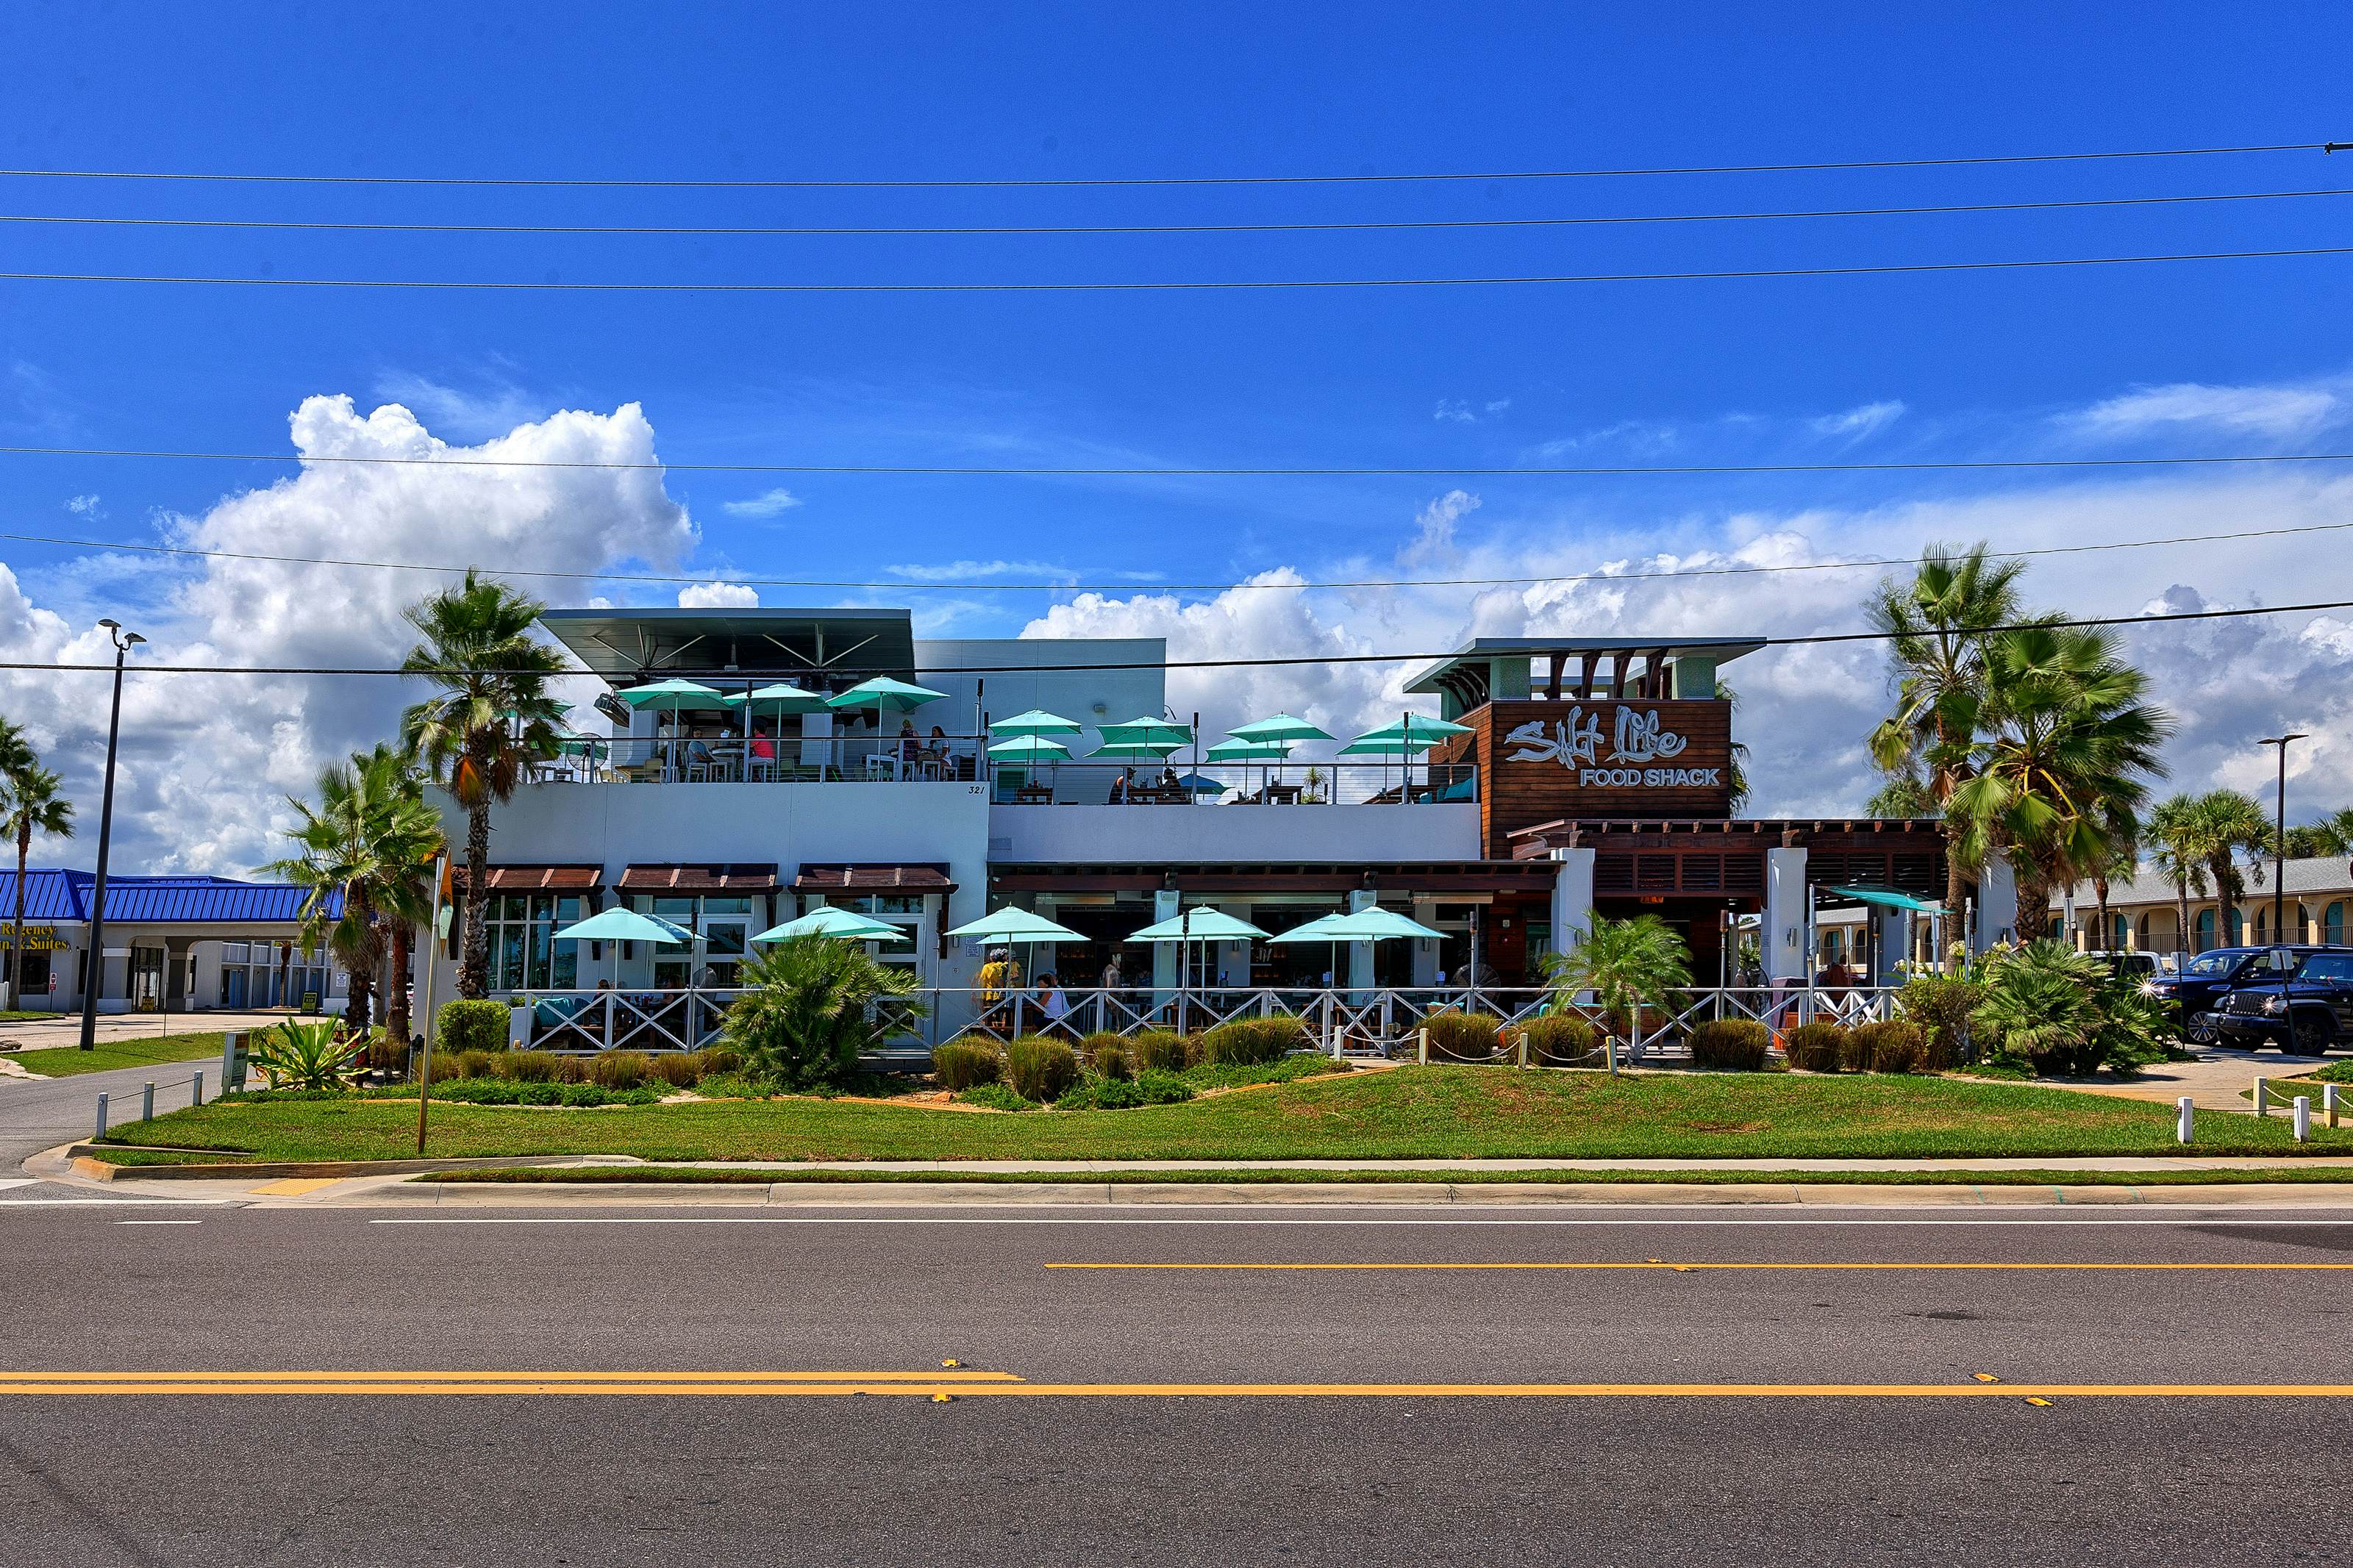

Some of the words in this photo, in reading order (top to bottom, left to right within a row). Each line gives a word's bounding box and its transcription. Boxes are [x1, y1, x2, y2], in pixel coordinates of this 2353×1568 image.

[1579, 769, 1641, 787] FOOD
[1643, 769, 1720, 787] SHACK
[968, 786, 985, 795] 321
[30, 937, 68, 950] Suites
